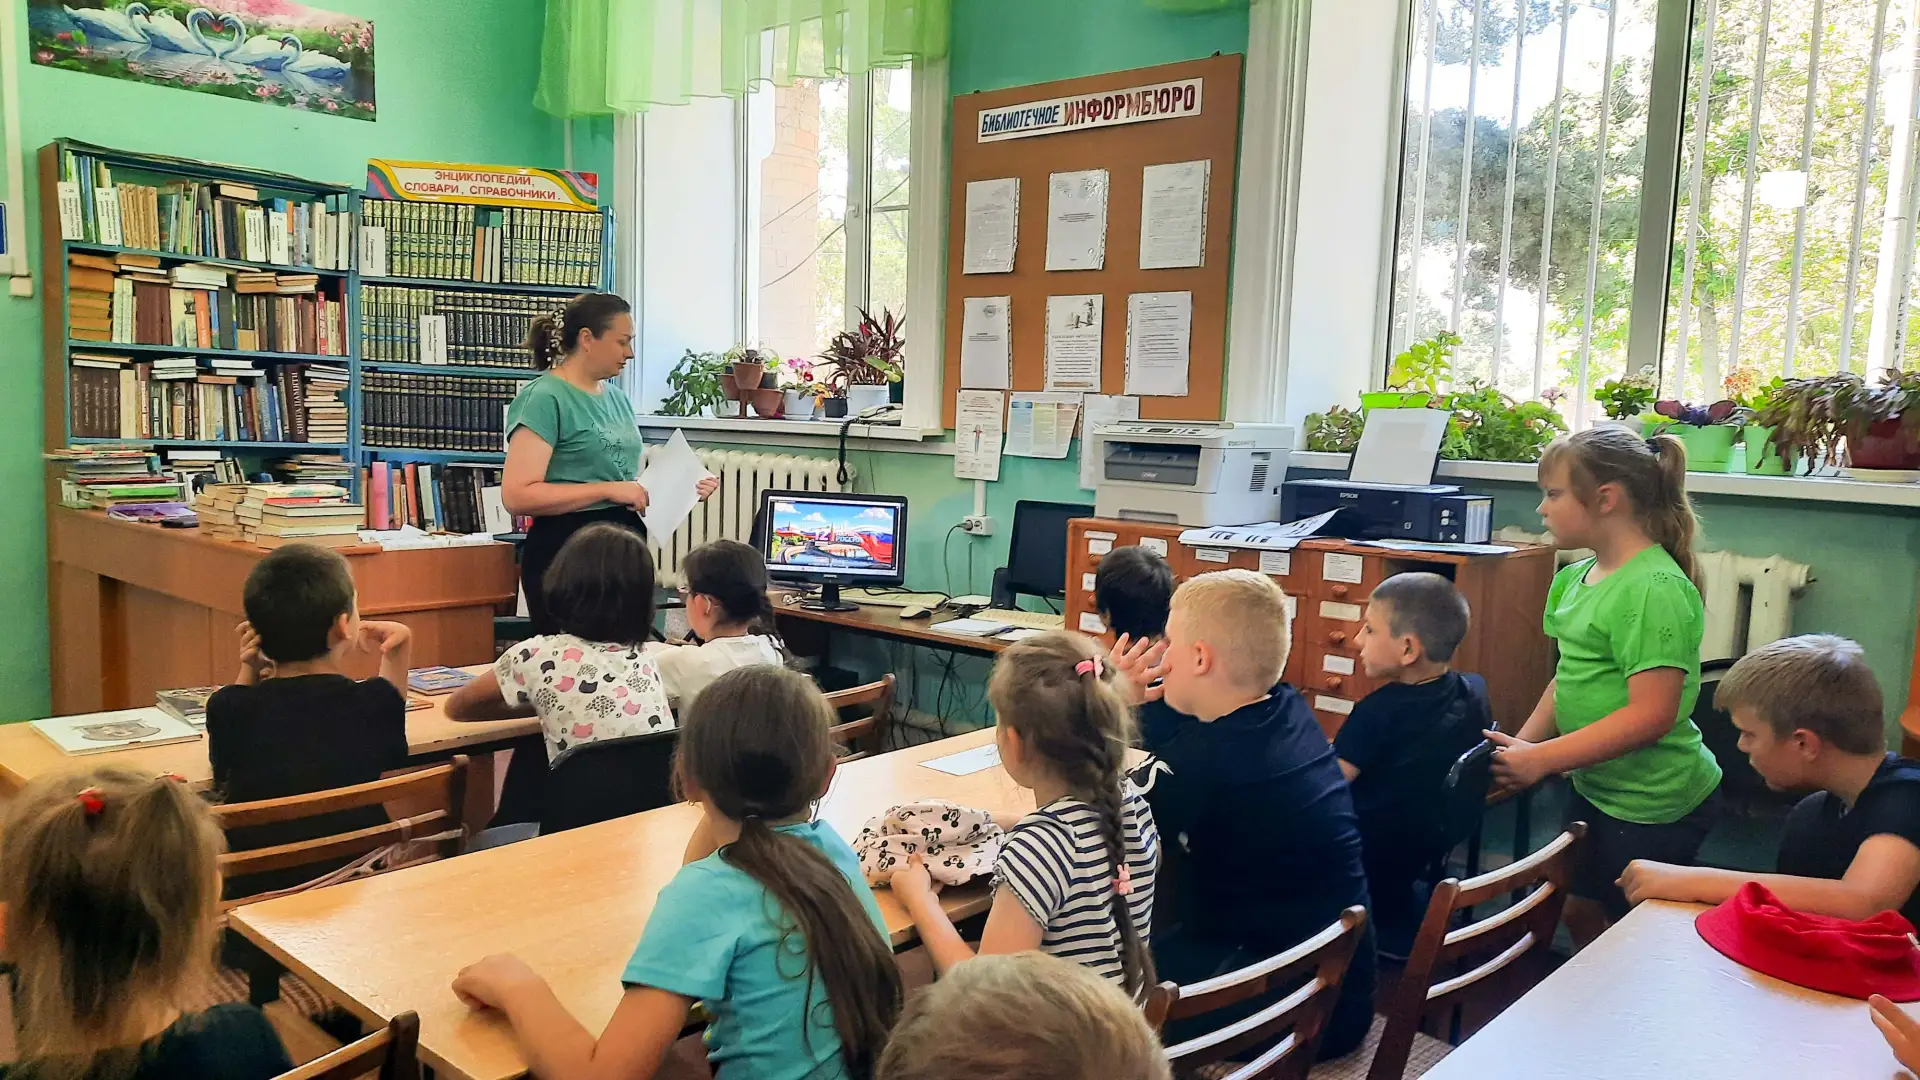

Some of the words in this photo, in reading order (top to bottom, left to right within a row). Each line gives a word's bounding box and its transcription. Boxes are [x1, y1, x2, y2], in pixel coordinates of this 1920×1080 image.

[981, 104, 1060, 133] БИБЛИОТЕЧНОЕ
[1064, 84, 1196, 126] ИНФОРМБЮРО
[435, 170, 535, 187] ЭНЦИКЛОПЕДИИ,
